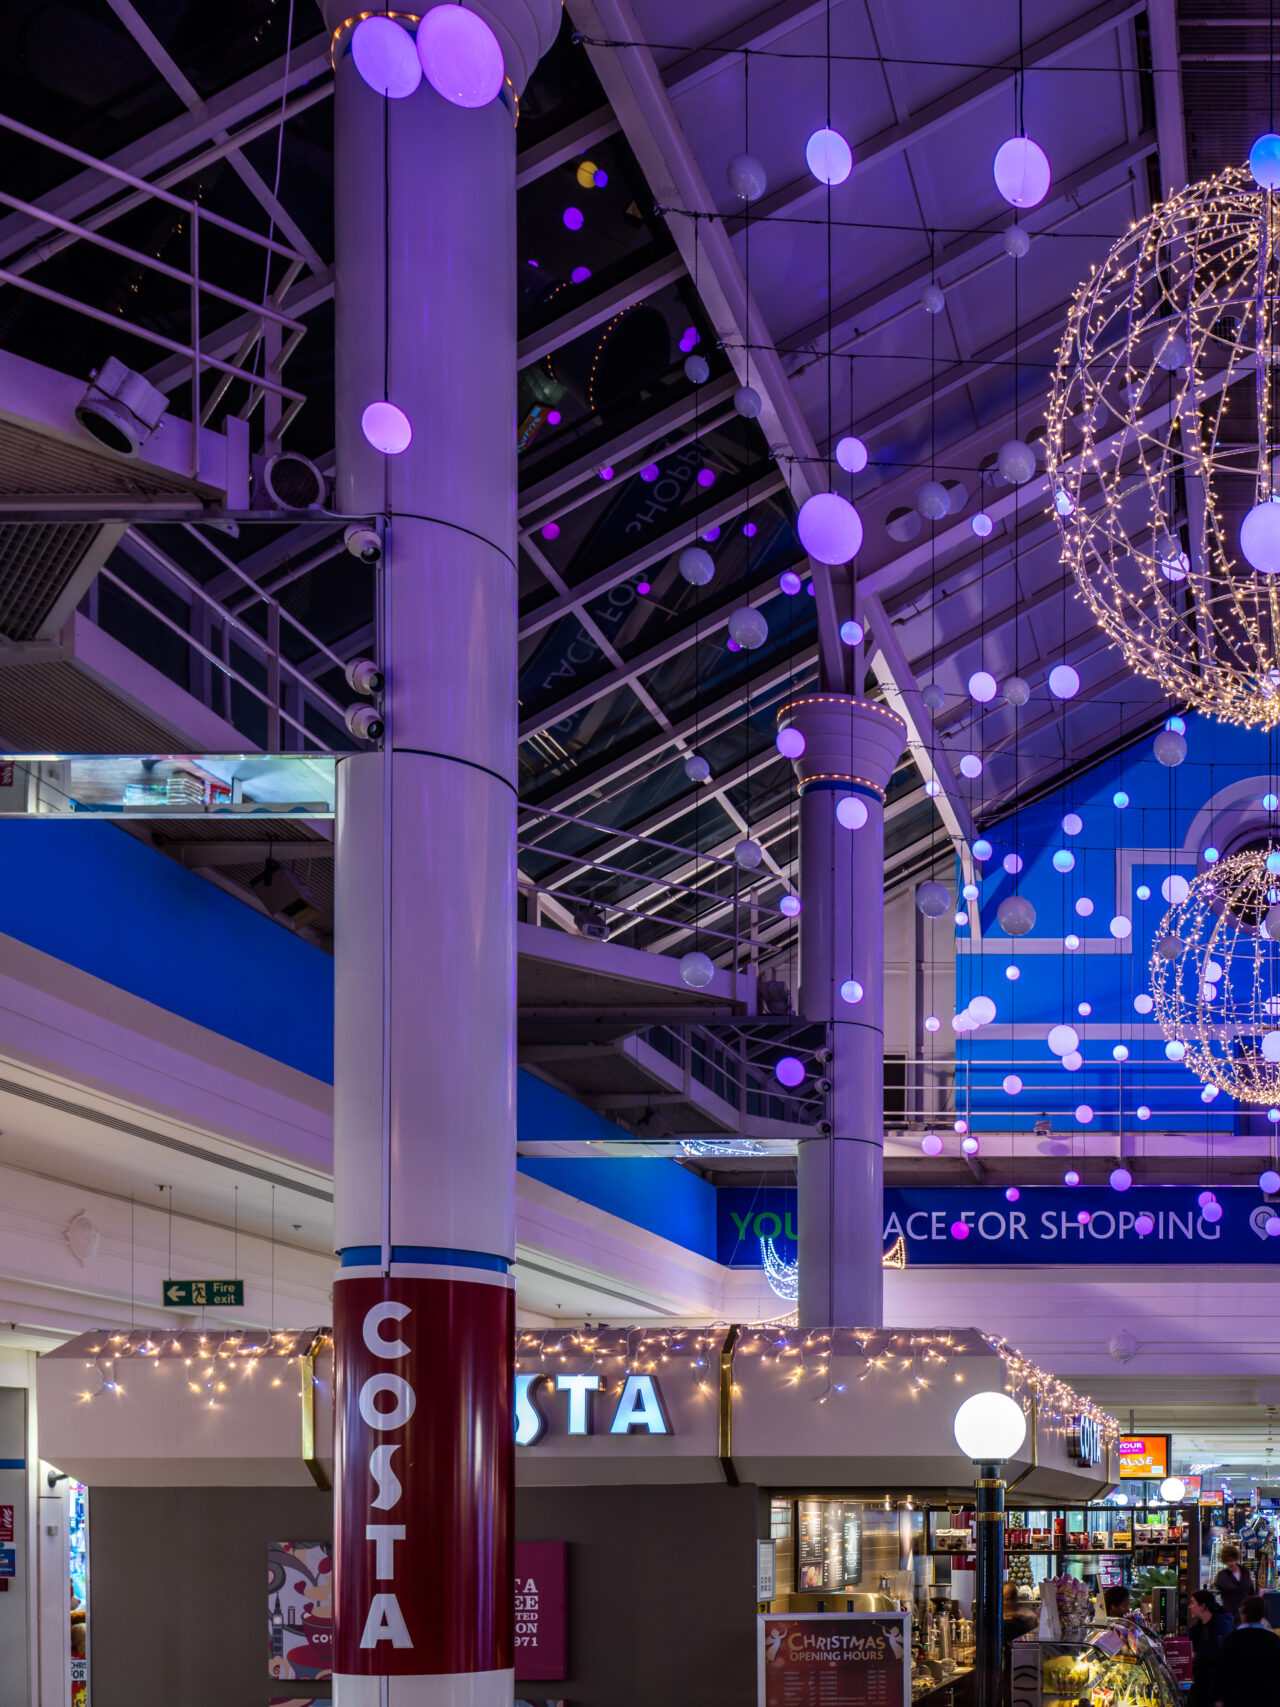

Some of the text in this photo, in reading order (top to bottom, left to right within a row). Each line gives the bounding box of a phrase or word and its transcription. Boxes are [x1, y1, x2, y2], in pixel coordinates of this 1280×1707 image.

[731, 1212, 798, 1241] YOU
[882, 1211, 947, 1240] ACE
[960, 1211, 1029, 1240] FOR
[213, 1282, 236, 1293] Fire
[213, 1294, 236, 1304] exit
[515, 1374, 673, 1446] STA
[1119, 1456, 1154, 1467] ALUE
[358, 1301, 416, 1648] COSTA
[787, 1632, 886, 1651] CHRISTMAS
[789, 1651, 884, 1662] OPENING HOURS
[71, 1669, 85, 1679] OR
